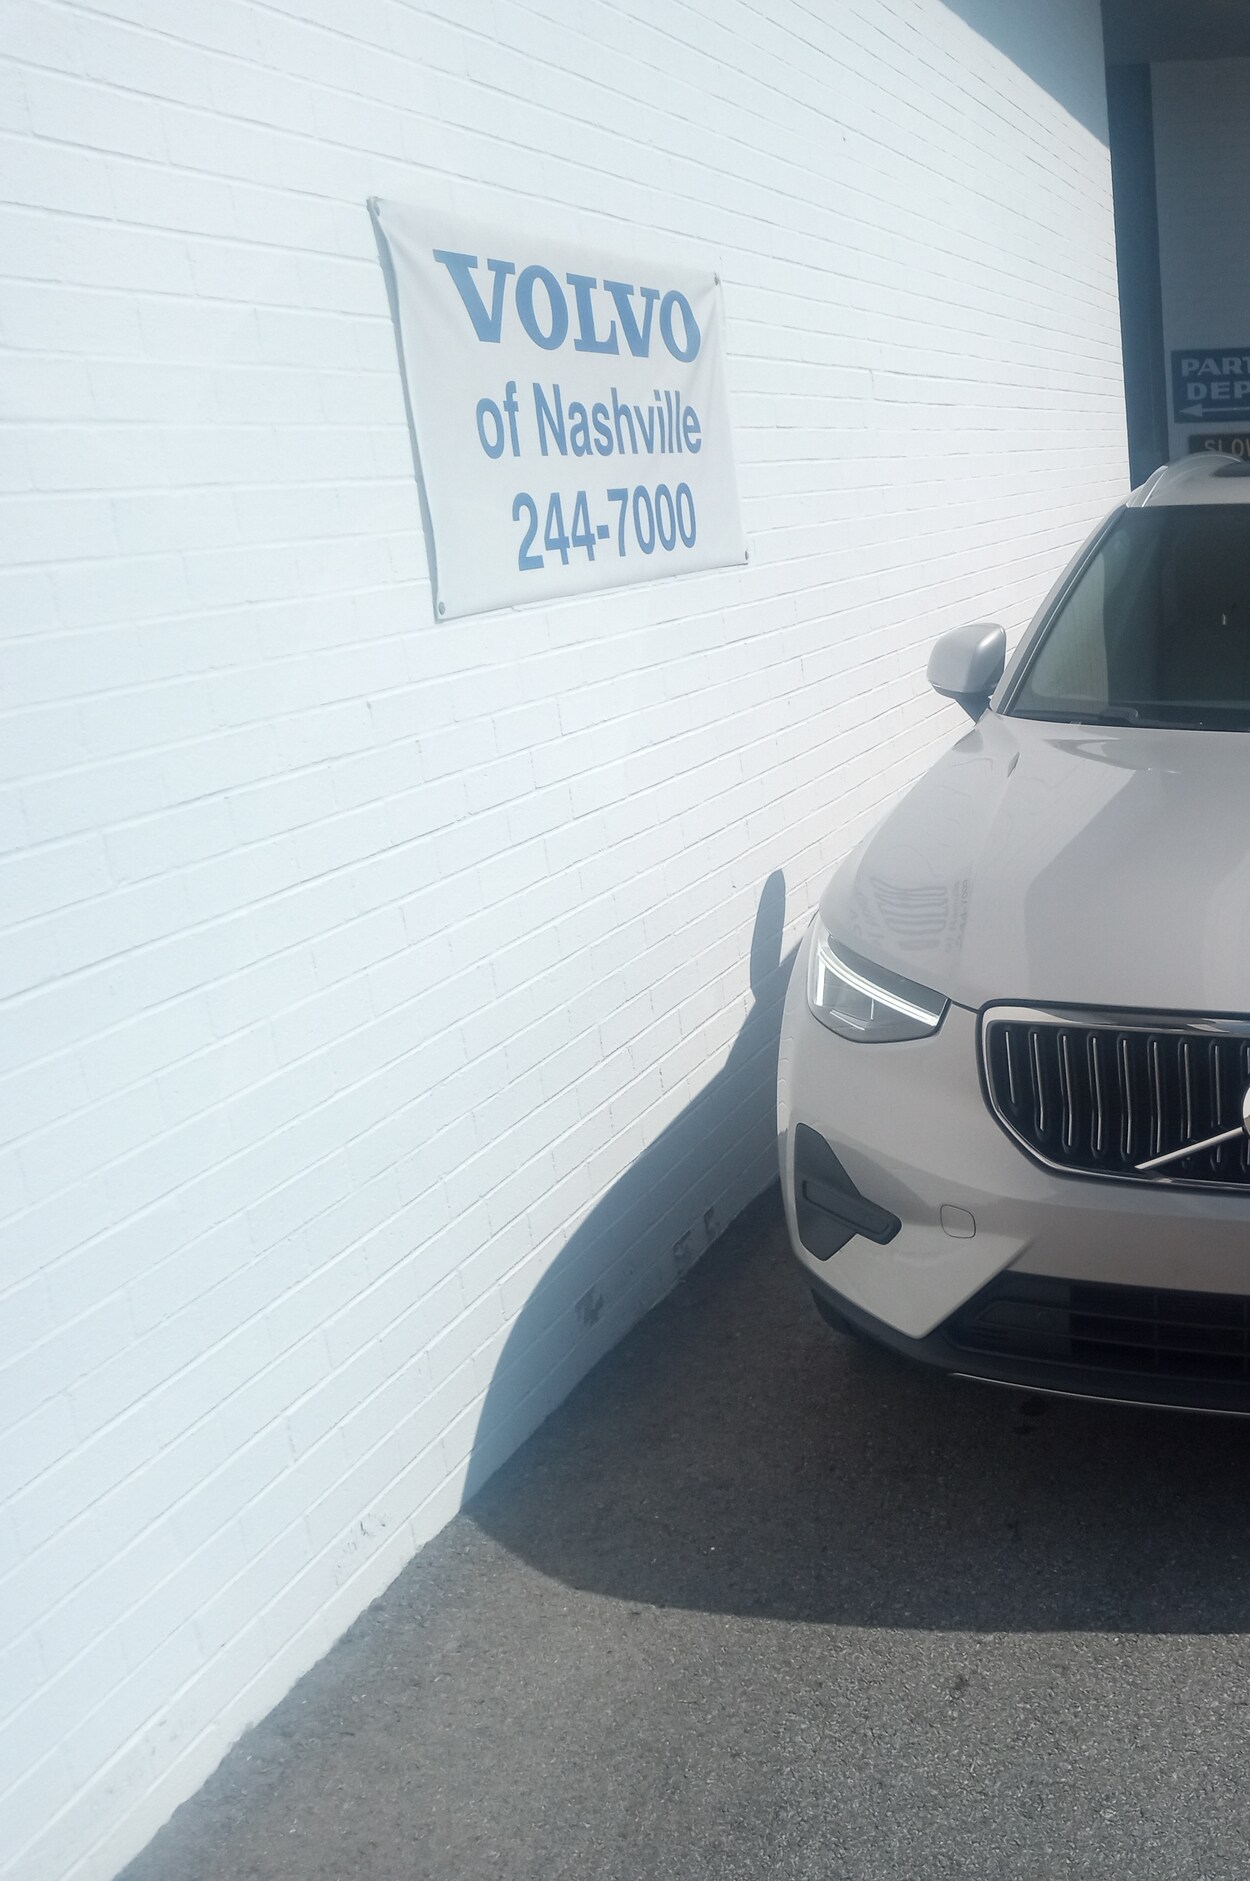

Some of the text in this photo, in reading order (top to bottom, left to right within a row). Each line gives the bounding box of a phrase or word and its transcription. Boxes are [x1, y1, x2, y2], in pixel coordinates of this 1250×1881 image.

[433, 249, 701, 363] VOLVO
[476, 381, 702, 459] of Nashville
[512, 482, 697, 571] 244-7000
